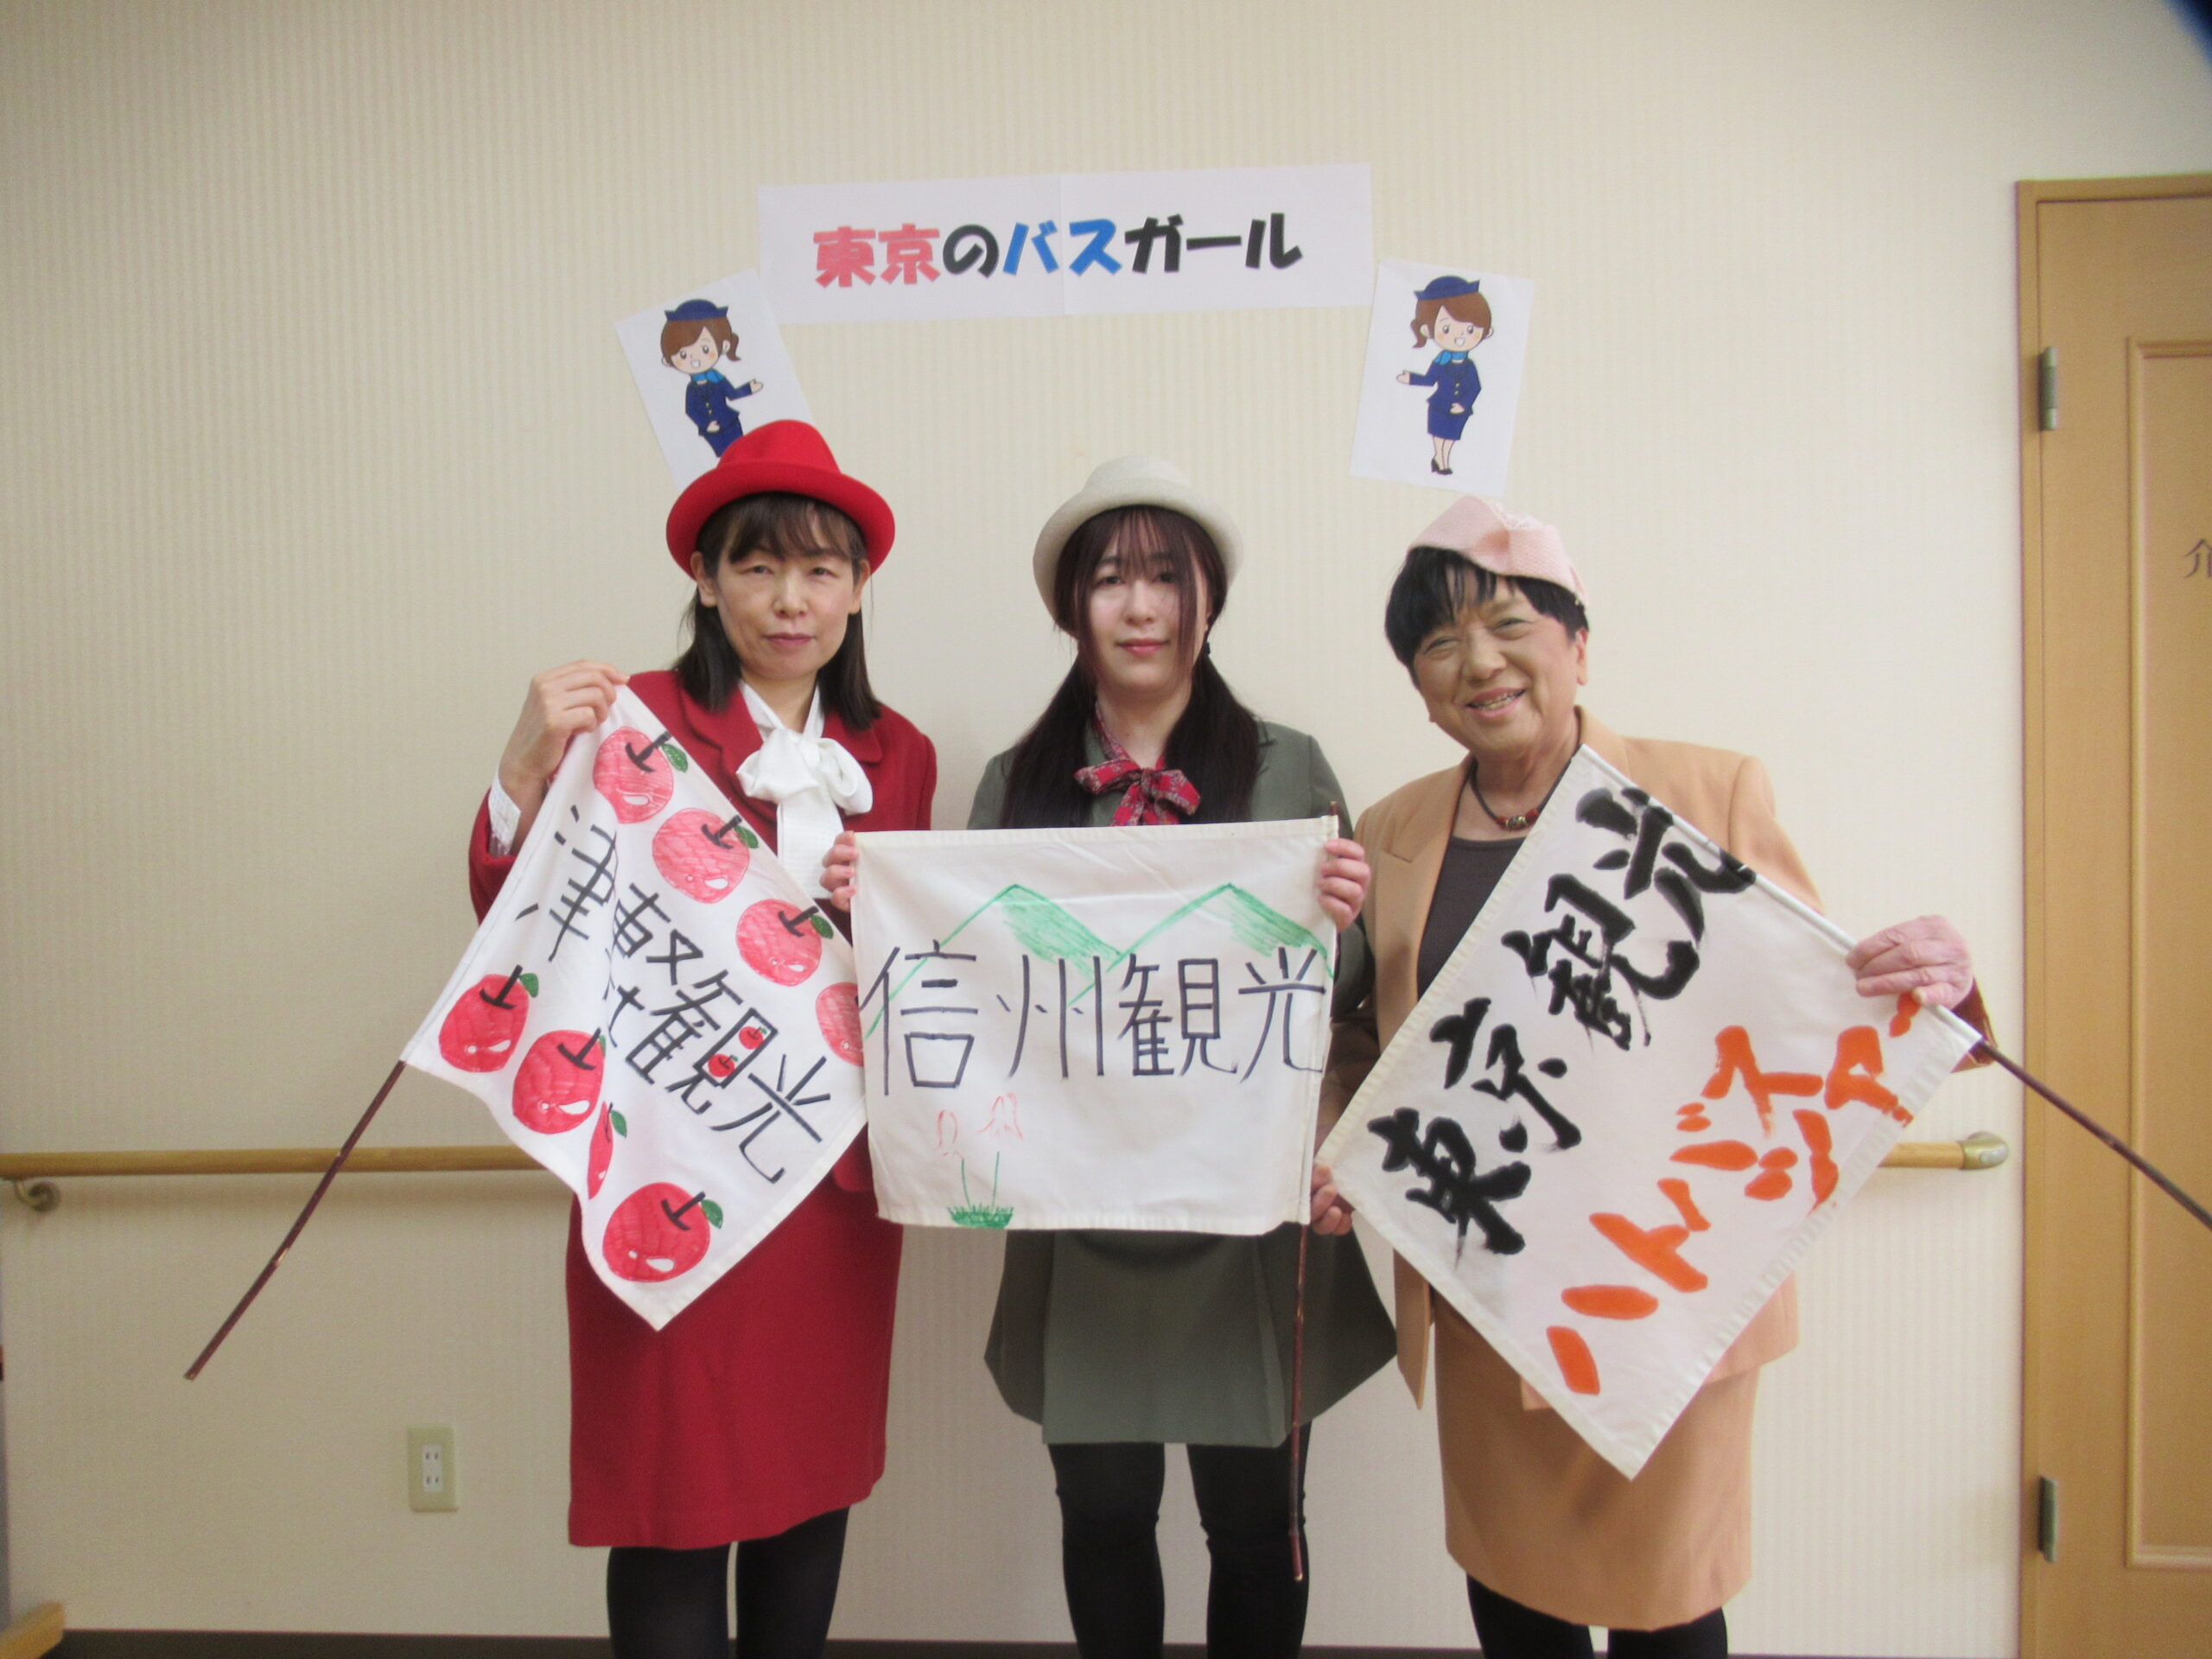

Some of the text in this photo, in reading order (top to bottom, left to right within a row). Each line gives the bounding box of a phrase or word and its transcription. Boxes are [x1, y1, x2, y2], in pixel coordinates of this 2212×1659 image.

[813, 213, 1303, 289] 東京のバスガール
[859, 939, 1326, 1096] 信州観光
[1367, 785, 1756, 1272] 東京観光
